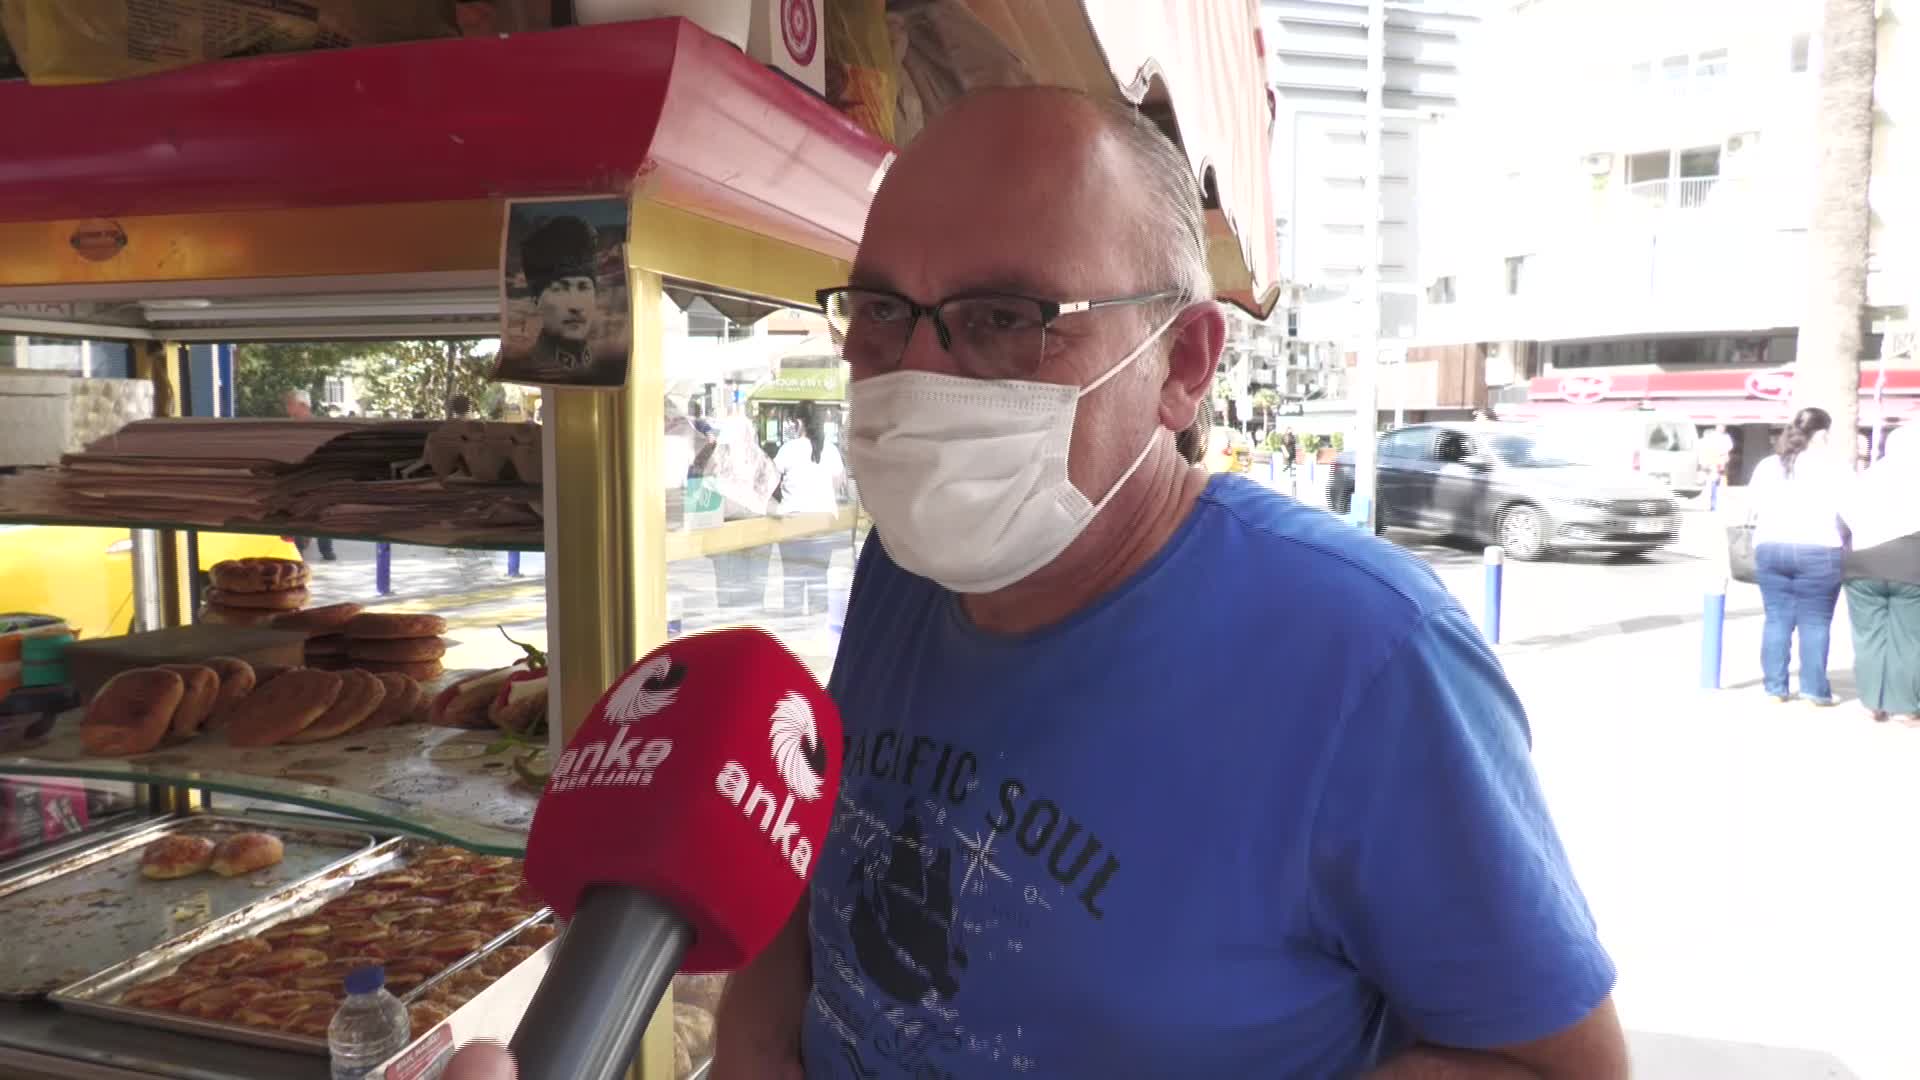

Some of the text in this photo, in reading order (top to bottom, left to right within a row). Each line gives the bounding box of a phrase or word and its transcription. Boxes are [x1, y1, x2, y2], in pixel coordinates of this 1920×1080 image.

[550, 768, 656, 794] ABER AJANS
[551, 723, 673, 780] anka
[714, 759, 813, 880] anka
[984, 778, 1121, 920] SOUL
